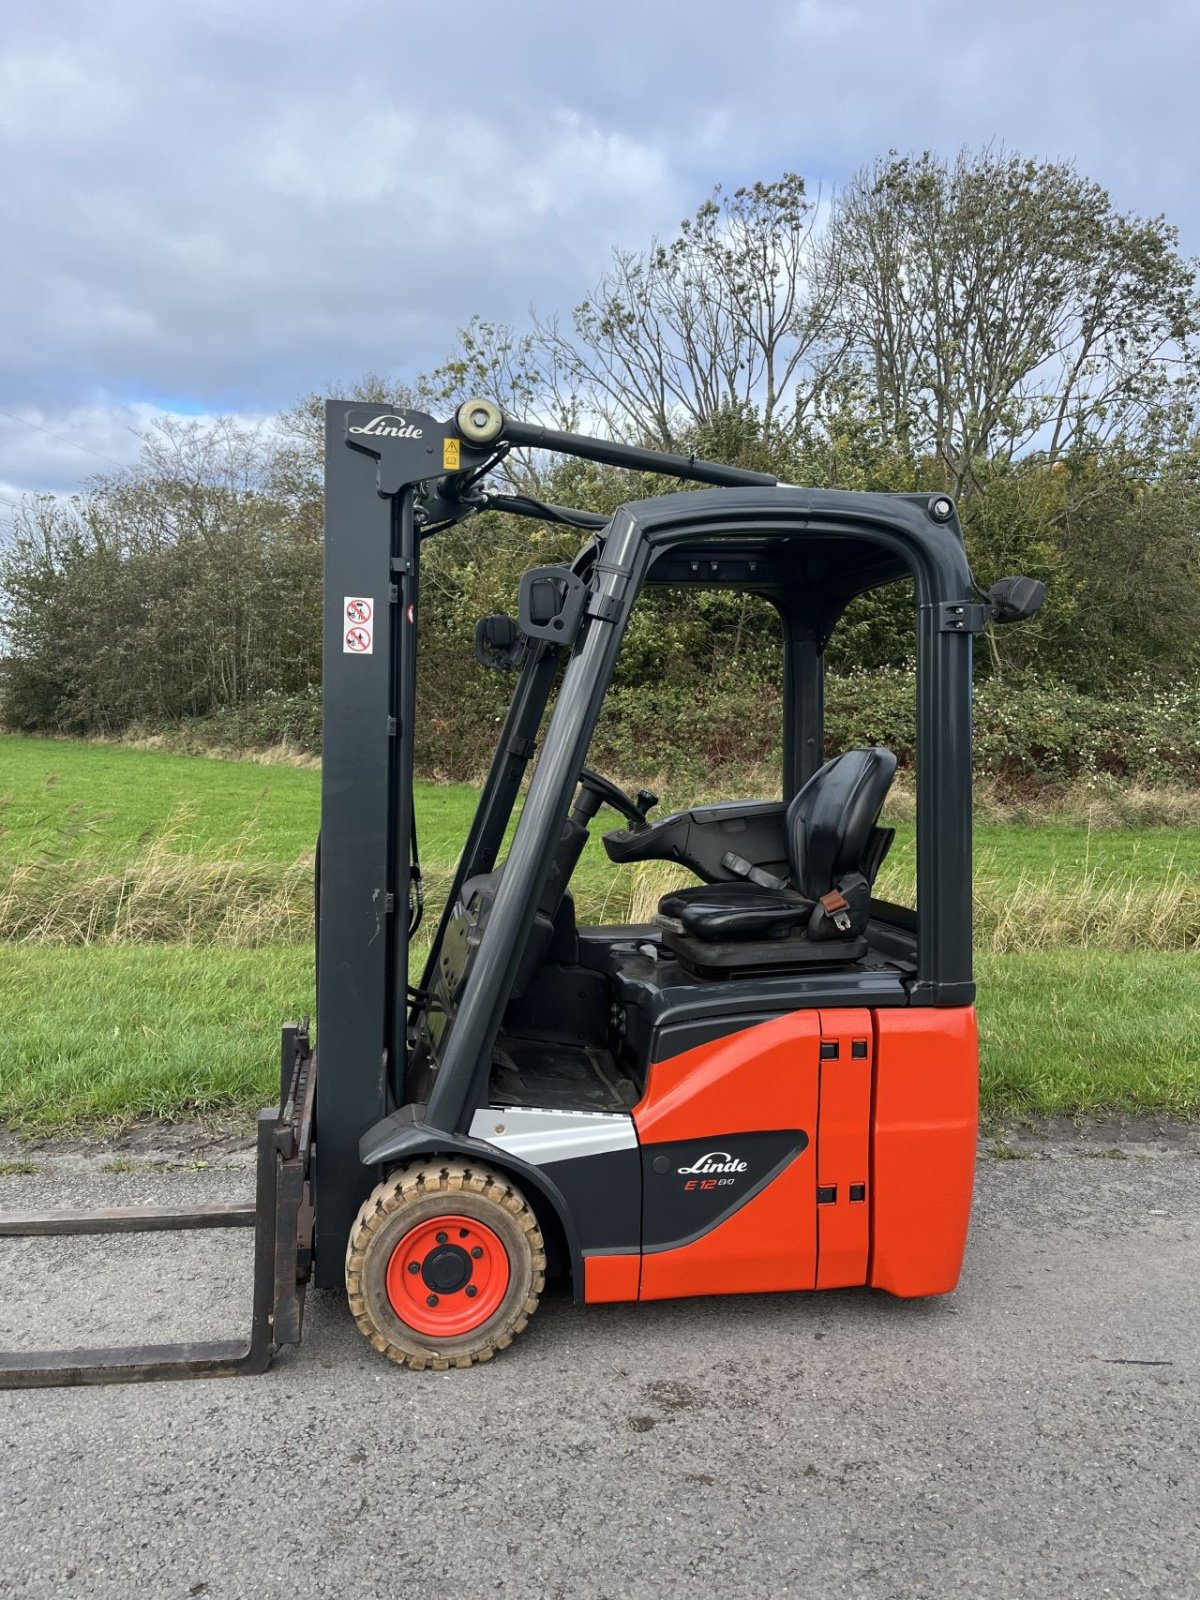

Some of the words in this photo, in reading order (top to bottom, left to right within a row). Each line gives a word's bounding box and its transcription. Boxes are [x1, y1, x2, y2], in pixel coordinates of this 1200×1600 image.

[349, 414, 423, 439] Linde
[677, 1152, 747, 1174] Linde
[684, 1180, 698, 1190] E
[700, 1179, 717, 1190] 12
